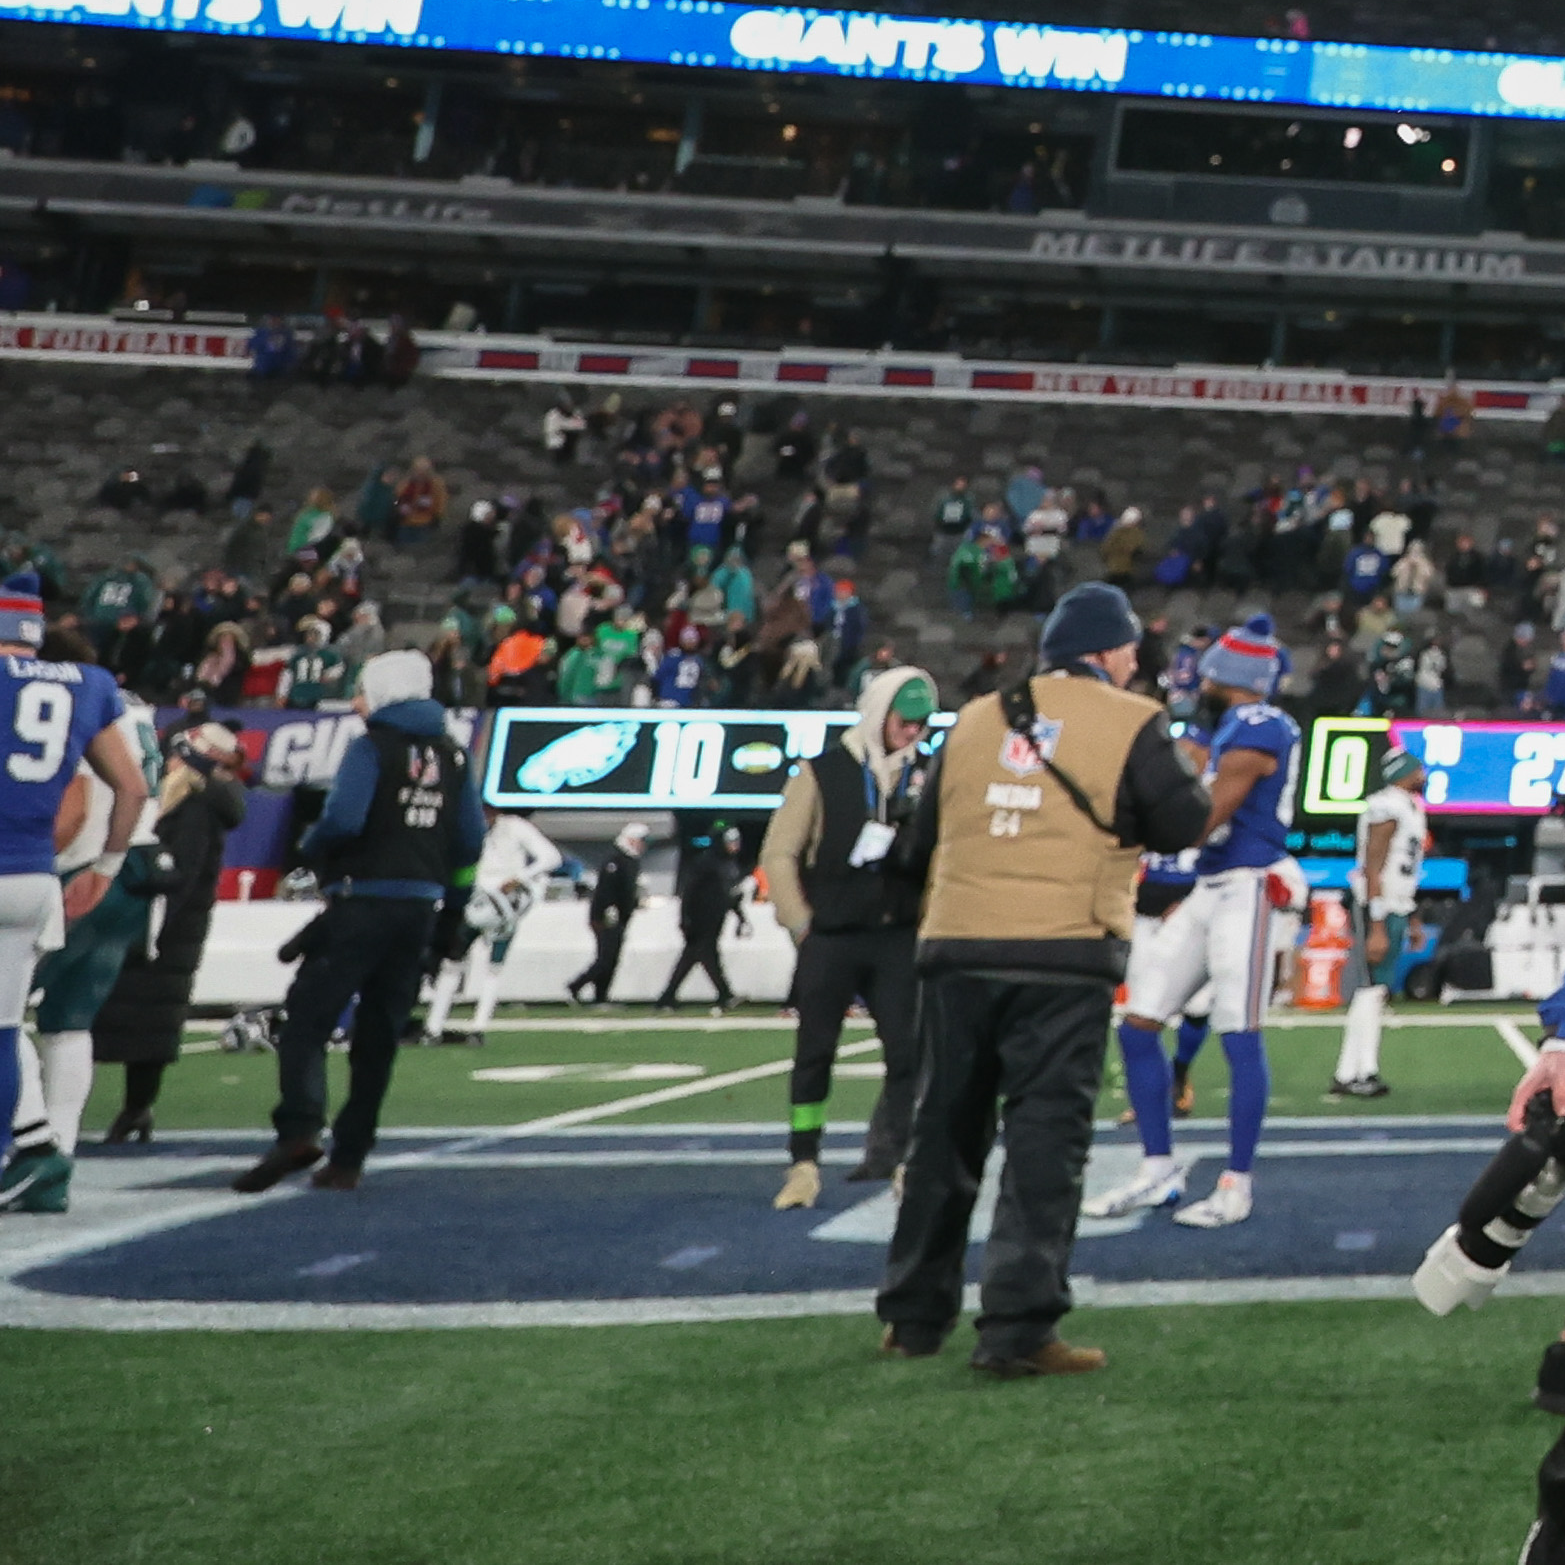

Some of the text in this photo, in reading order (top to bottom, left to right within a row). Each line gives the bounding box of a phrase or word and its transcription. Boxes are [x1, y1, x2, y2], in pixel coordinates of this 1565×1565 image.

[730, 10, 1128, 83] GIANTS WIN
[6, 681, 74, 783] 9
[649, 720, 725, 797] 10
